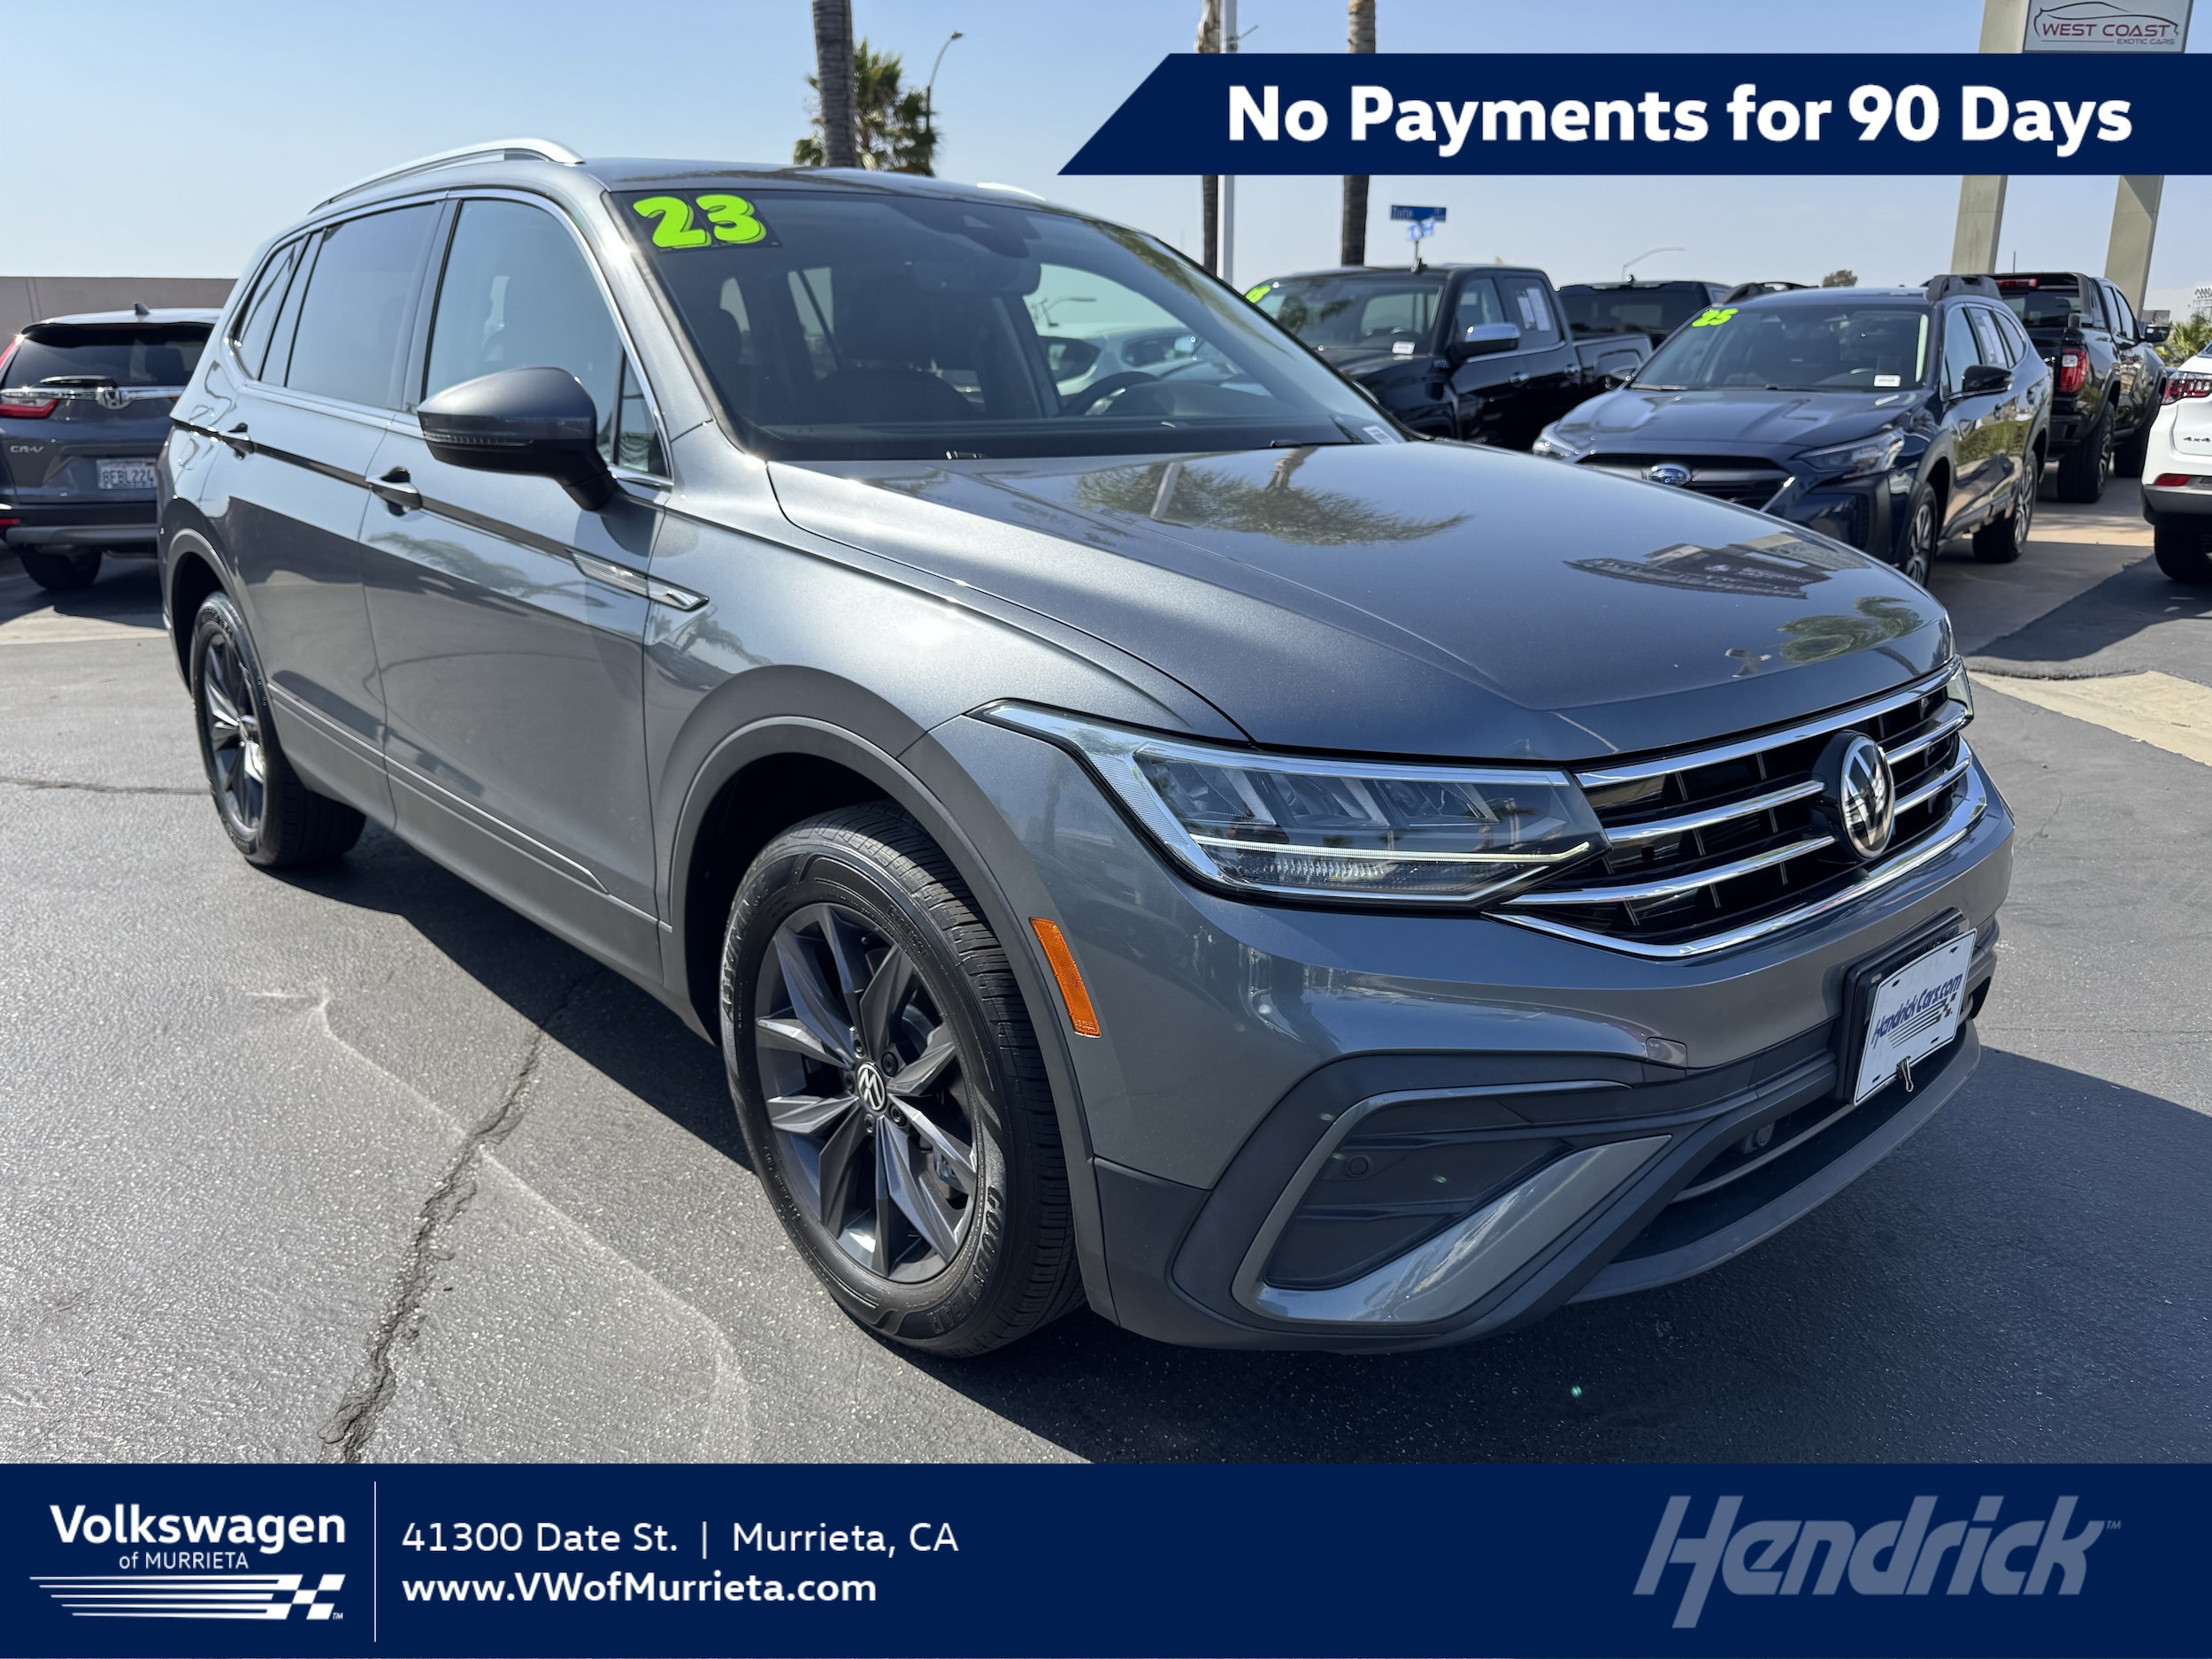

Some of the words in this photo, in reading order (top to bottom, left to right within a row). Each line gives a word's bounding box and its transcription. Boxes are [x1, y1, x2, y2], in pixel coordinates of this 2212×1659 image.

[2042, 23, 2097, 36] WEST
[2102, 24, 2170, 37] COAST
[633, 194, 767, 250] 23
[10, 445, 44, 454] CR-V
